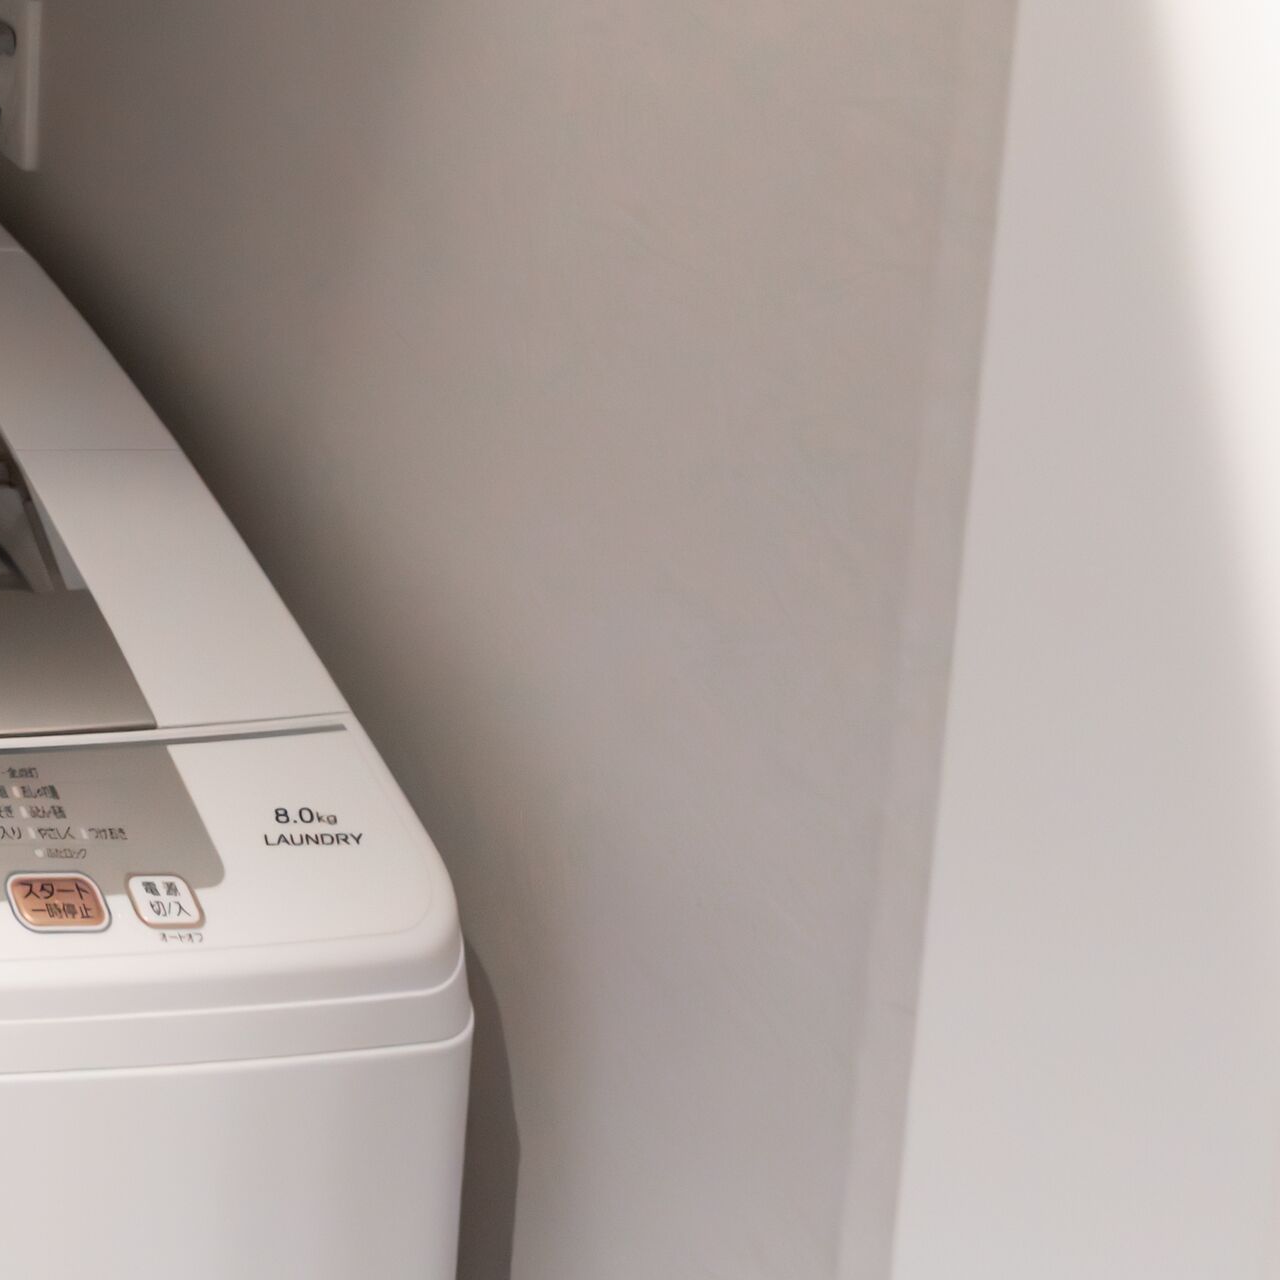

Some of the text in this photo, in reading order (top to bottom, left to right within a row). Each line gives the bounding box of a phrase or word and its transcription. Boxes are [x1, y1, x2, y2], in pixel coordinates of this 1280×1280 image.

[274, 807, 338, 826] 8.0kg
[263, 833, 363, 847] LAUNDRY
[20, 881, 91, 901] スタート
[32, 903, 95, 921] 一時停止
[149, 901, 192, 918] 切/入
